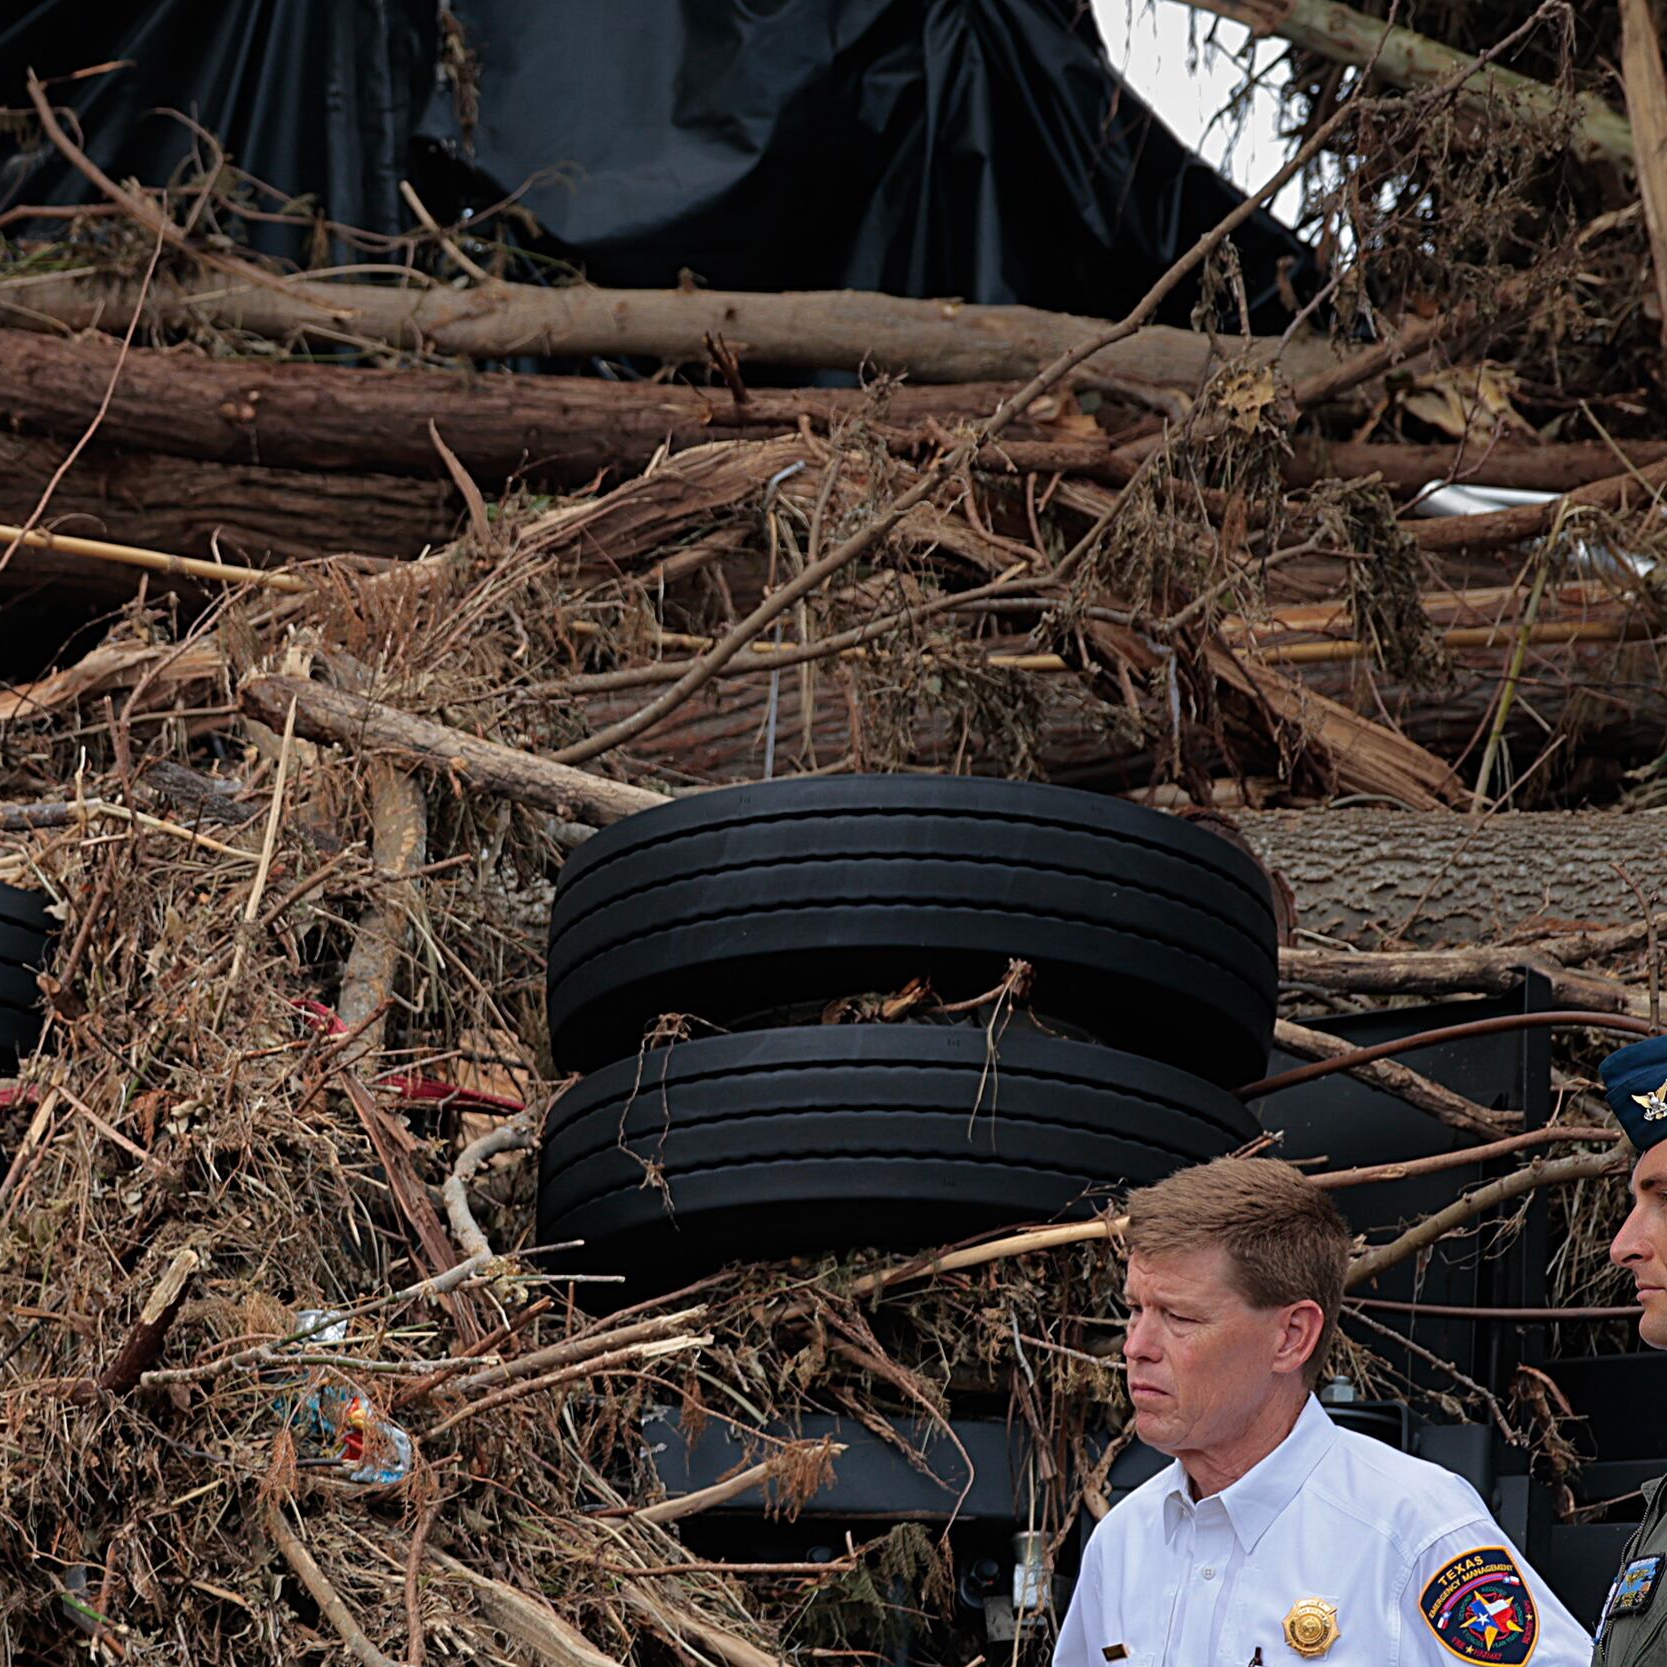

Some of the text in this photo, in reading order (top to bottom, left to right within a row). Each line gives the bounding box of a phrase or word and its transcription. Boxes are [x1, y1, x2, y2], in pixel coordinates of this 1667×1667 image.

[1428, 1563, 1514, 1619] EMERGENCY MANAGEMENT
[1437, 1555, 1484, 1587] TEXAS
